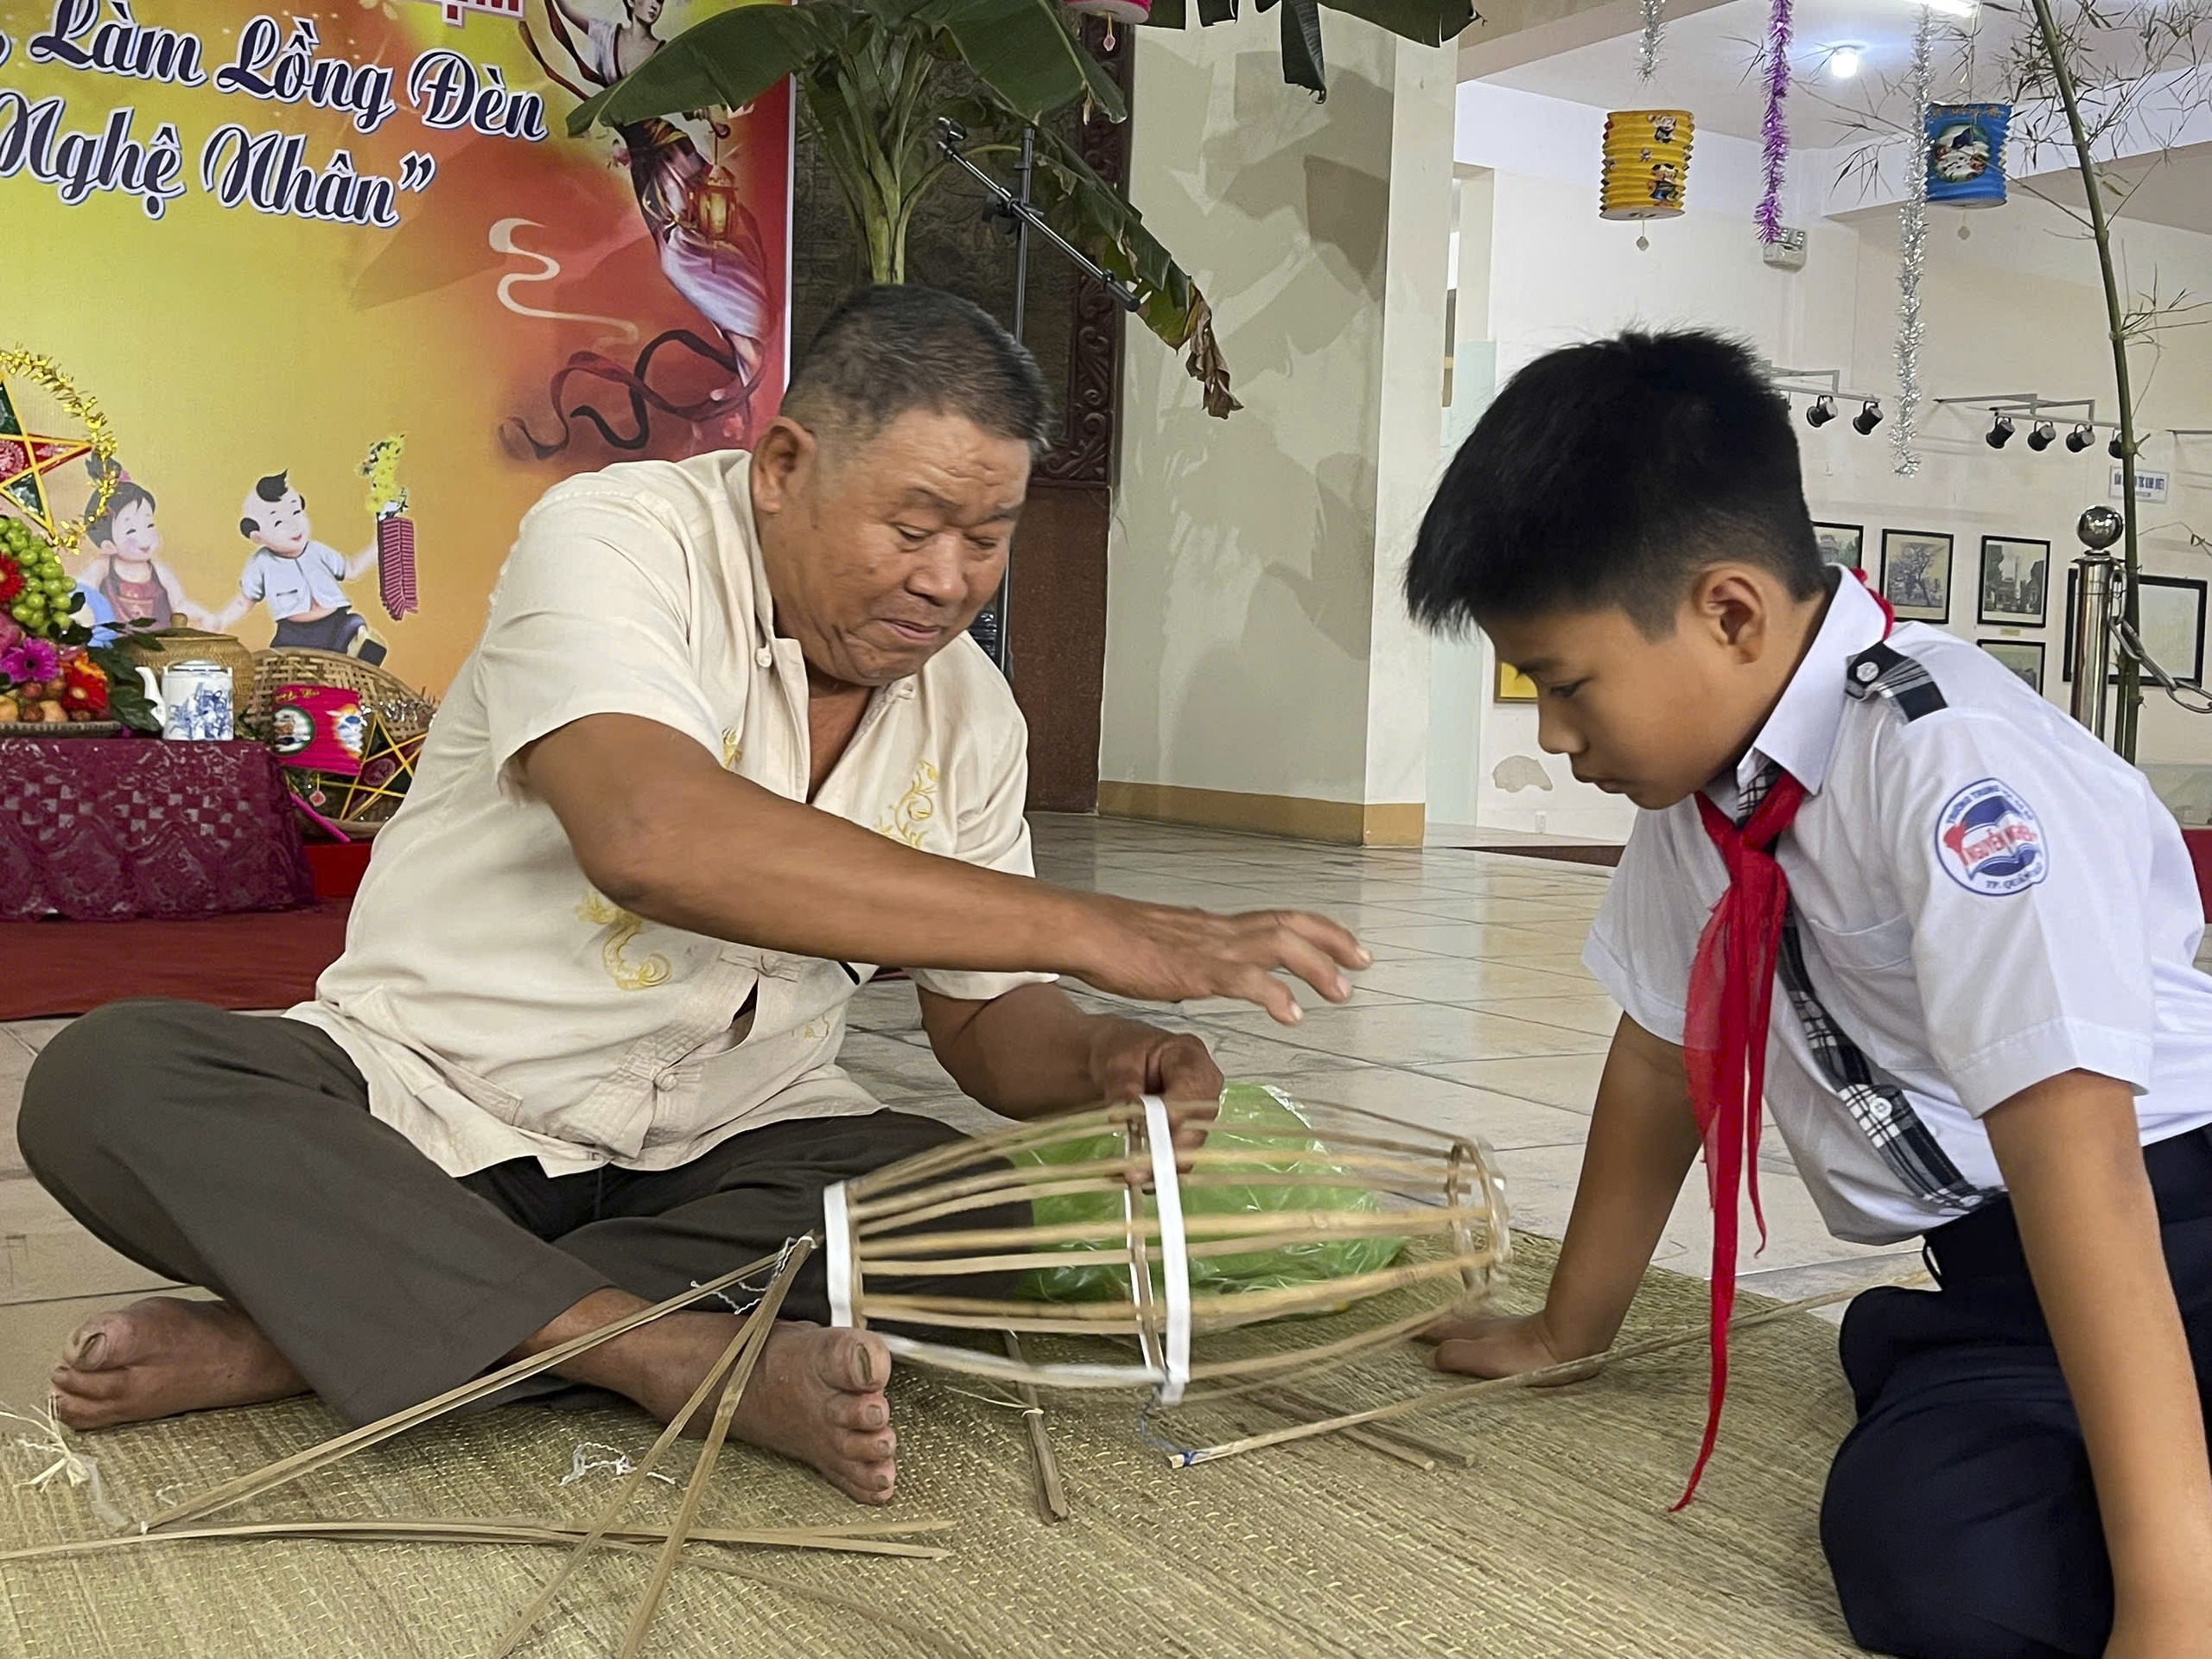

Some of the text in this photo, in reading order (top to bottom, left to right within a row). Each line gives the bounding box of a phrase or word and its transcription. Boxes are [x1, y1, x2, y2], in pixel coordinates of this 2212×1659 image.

[29, 0, 549, 141] Làm Lồng Đèn
[0, 91, 185, 219] Nghệ
